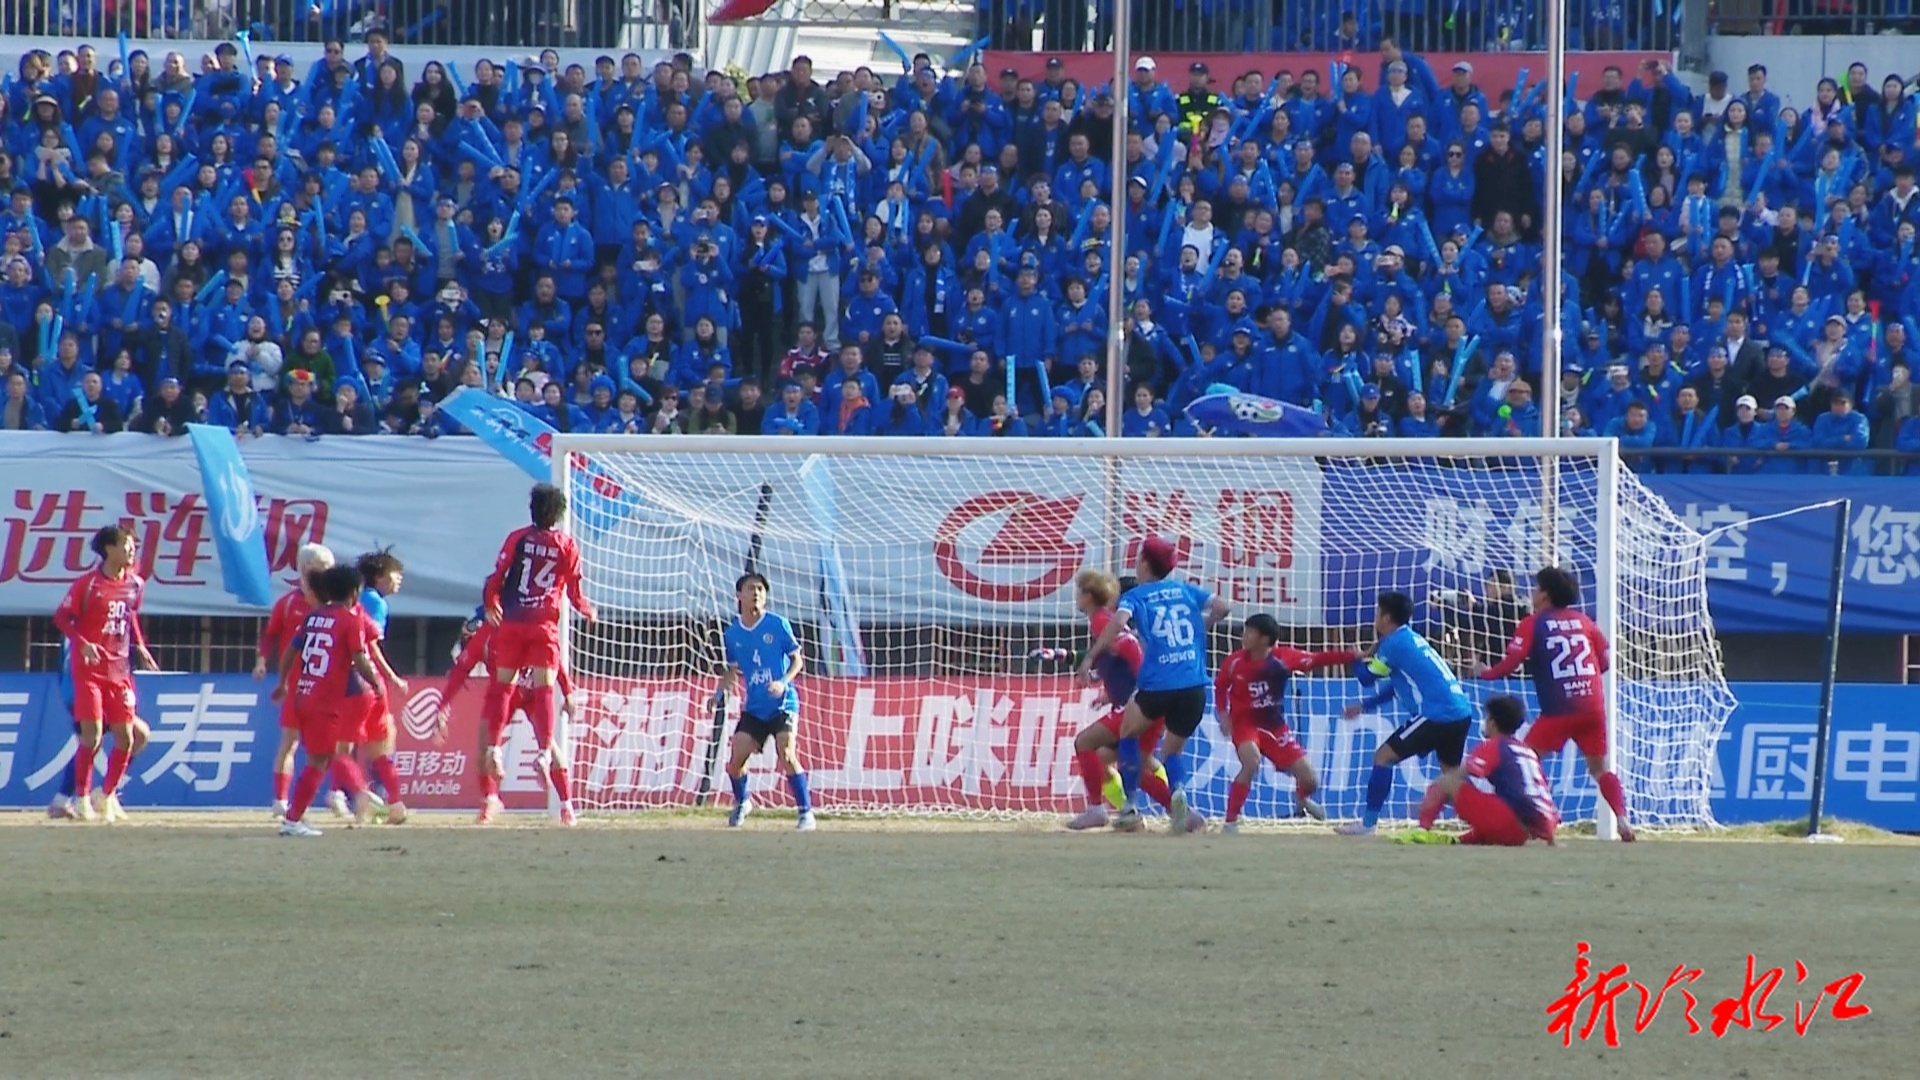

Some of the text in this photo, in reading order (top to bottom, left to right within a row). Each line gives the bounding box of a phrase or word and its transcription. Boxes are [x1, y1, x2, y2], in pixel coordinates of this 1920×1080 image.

[518, 557, 557, 595] 14
[107, 600, 126, 618] 30
[1151, 604, 1195, 647] 46
[752, 649, 762, 667] 4
[1545, 634, 1596, 679] 22
[1563, 680, 1592, 690] SANY
[0, 683, 258, 791] 人寿
[393, 750, 467, 777] 国移动
[411, 780, 461, 796] Mobile
